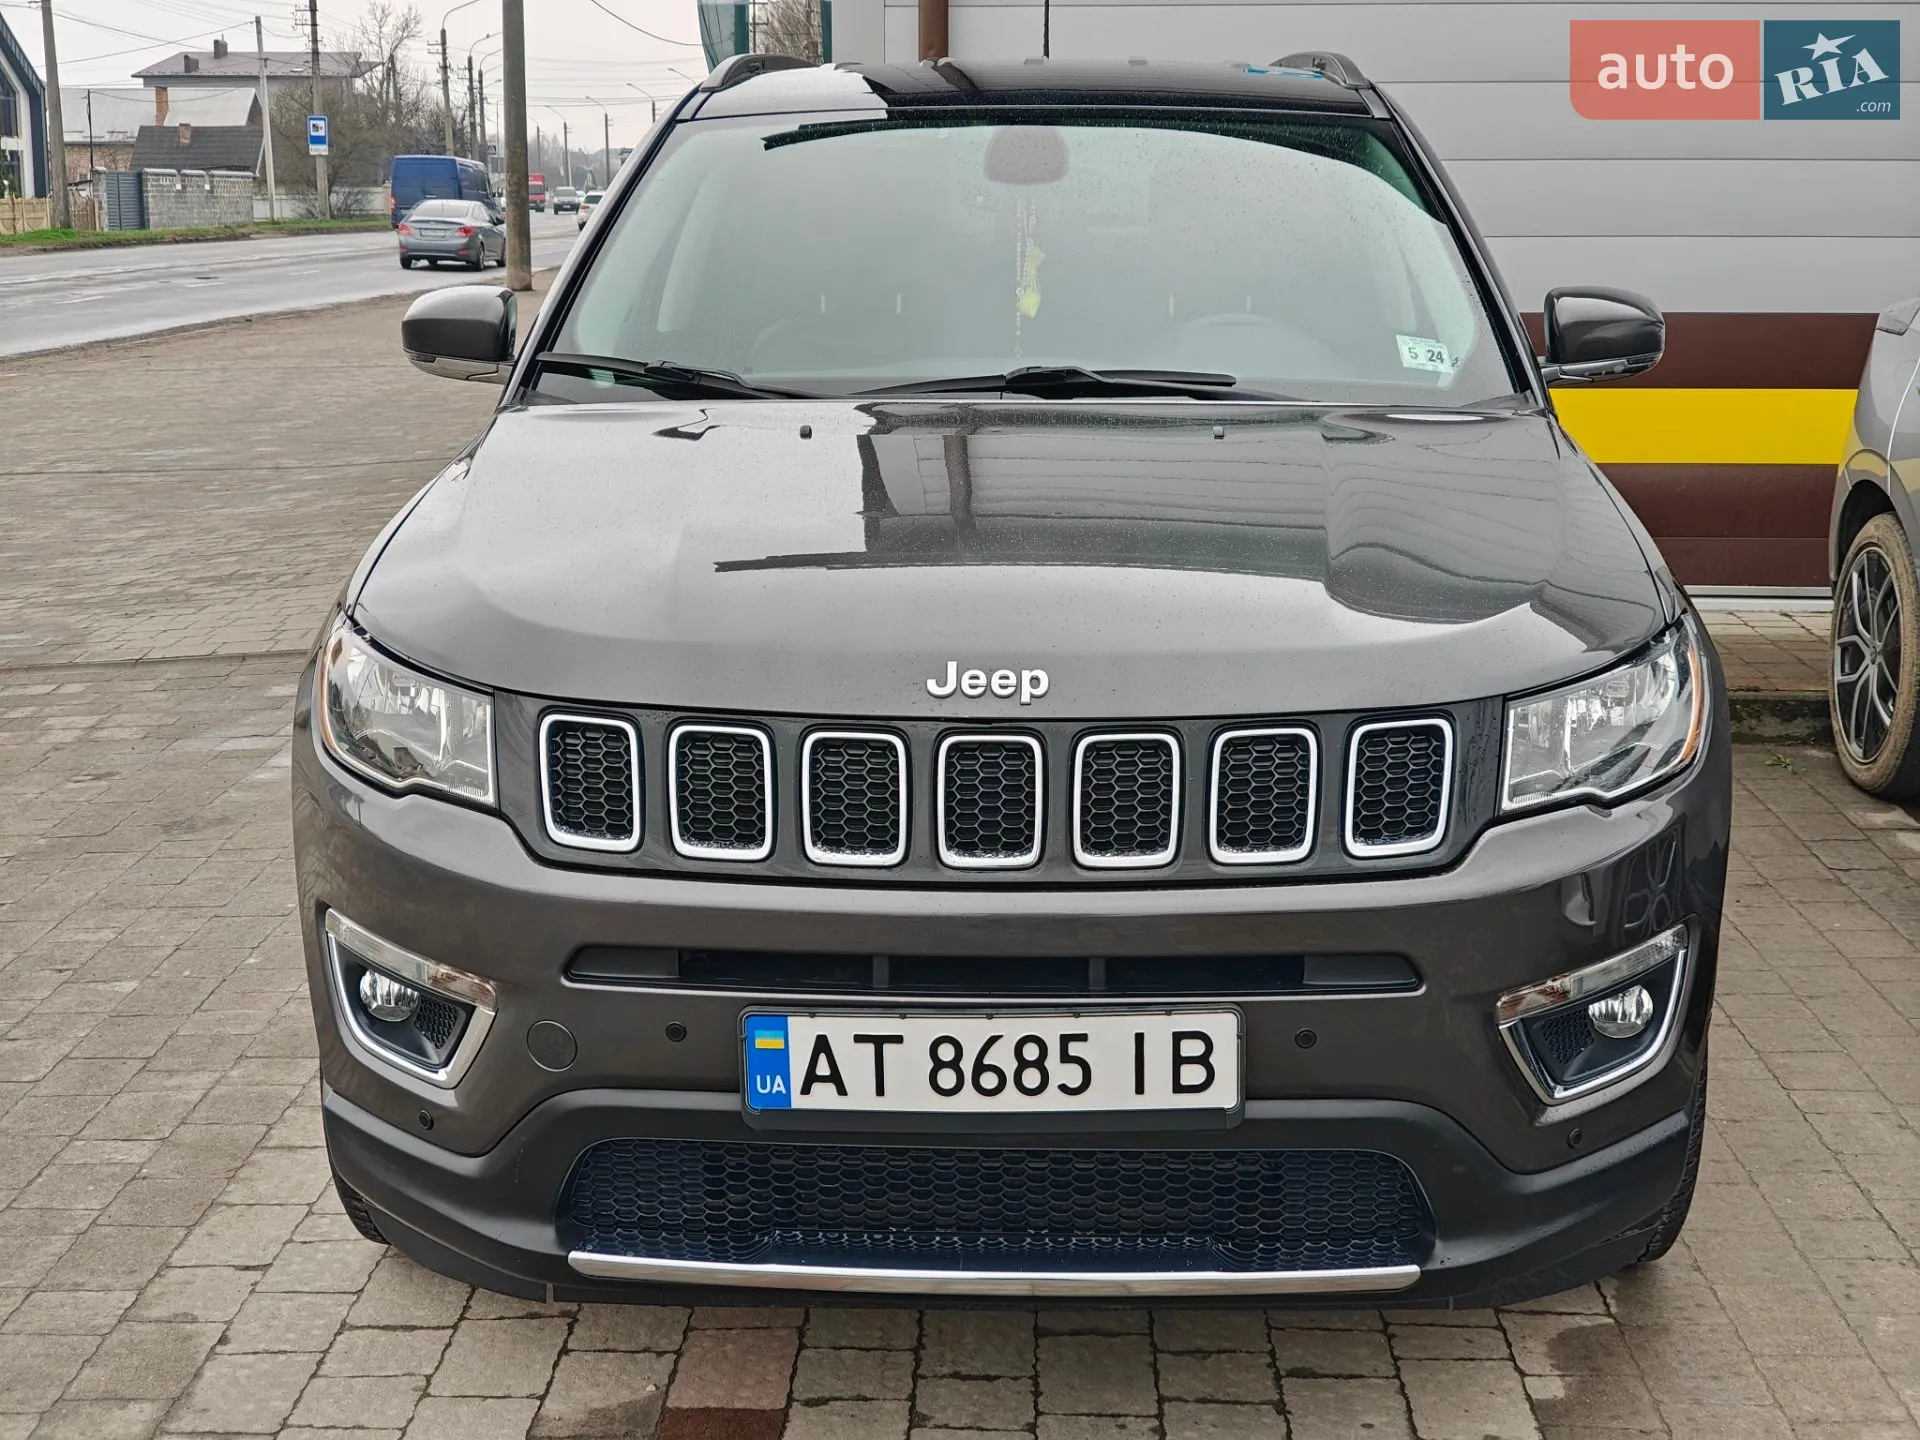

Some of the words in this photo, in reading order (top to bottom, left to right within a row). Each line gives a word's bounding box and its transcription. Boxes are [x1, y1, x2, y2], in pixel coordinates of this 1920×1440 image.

[1407, 346, 1419, 360] 5
[1427, 349, 1445, 364] 24
[926, 660, 1049, 705] Jeep
[800, 1034, 904, 1097] AT
[928, 1033, 1092, 1097] 8685
[1134, 1030, 1216, 1095] IB
[756, 1074, 787, 1095] UA
